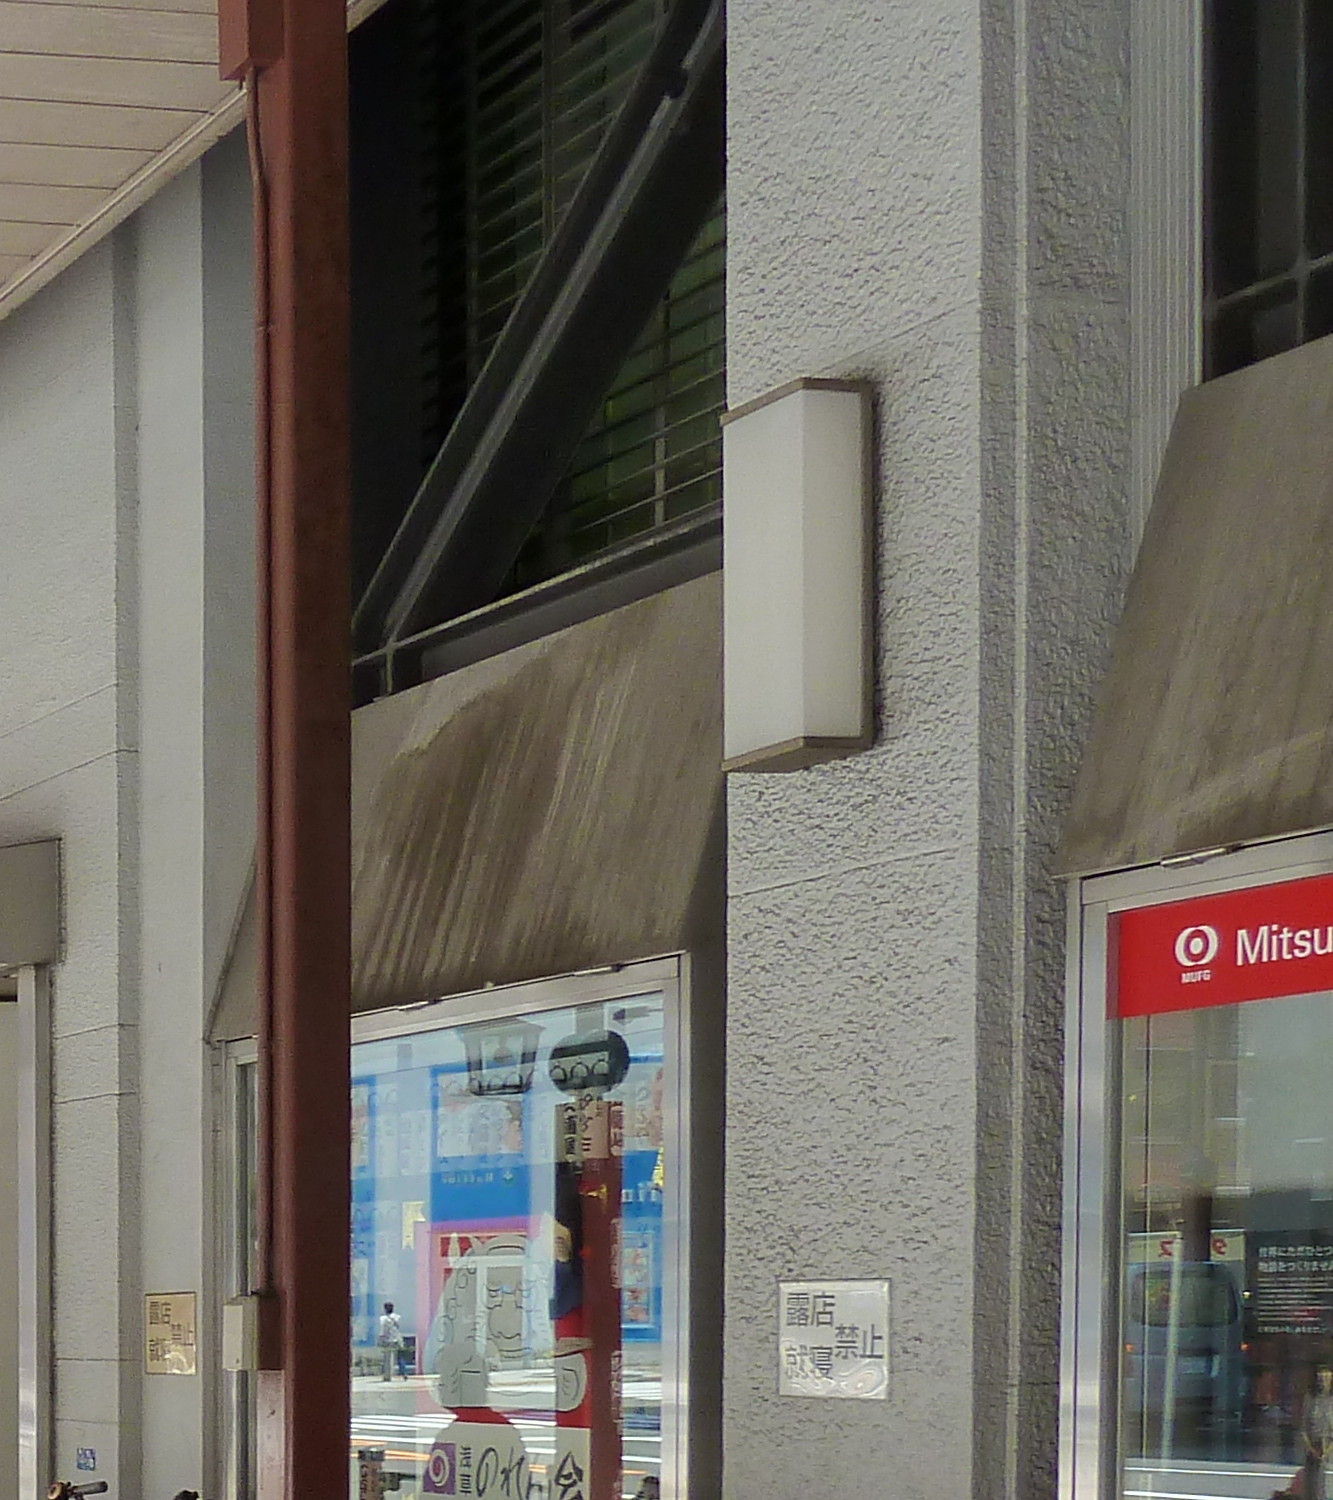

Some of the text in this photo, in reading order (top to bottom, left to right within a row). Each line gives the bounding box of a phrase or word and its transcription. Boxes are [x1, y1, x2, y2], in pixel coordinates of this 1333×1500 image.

[1236, 924, 1333, 967] Mitsu
[1181, 970, 1211, 983] MUFG
[787, 1291, 835, 1327] 露店
[834, 1323, 883, 1359] 禁止
